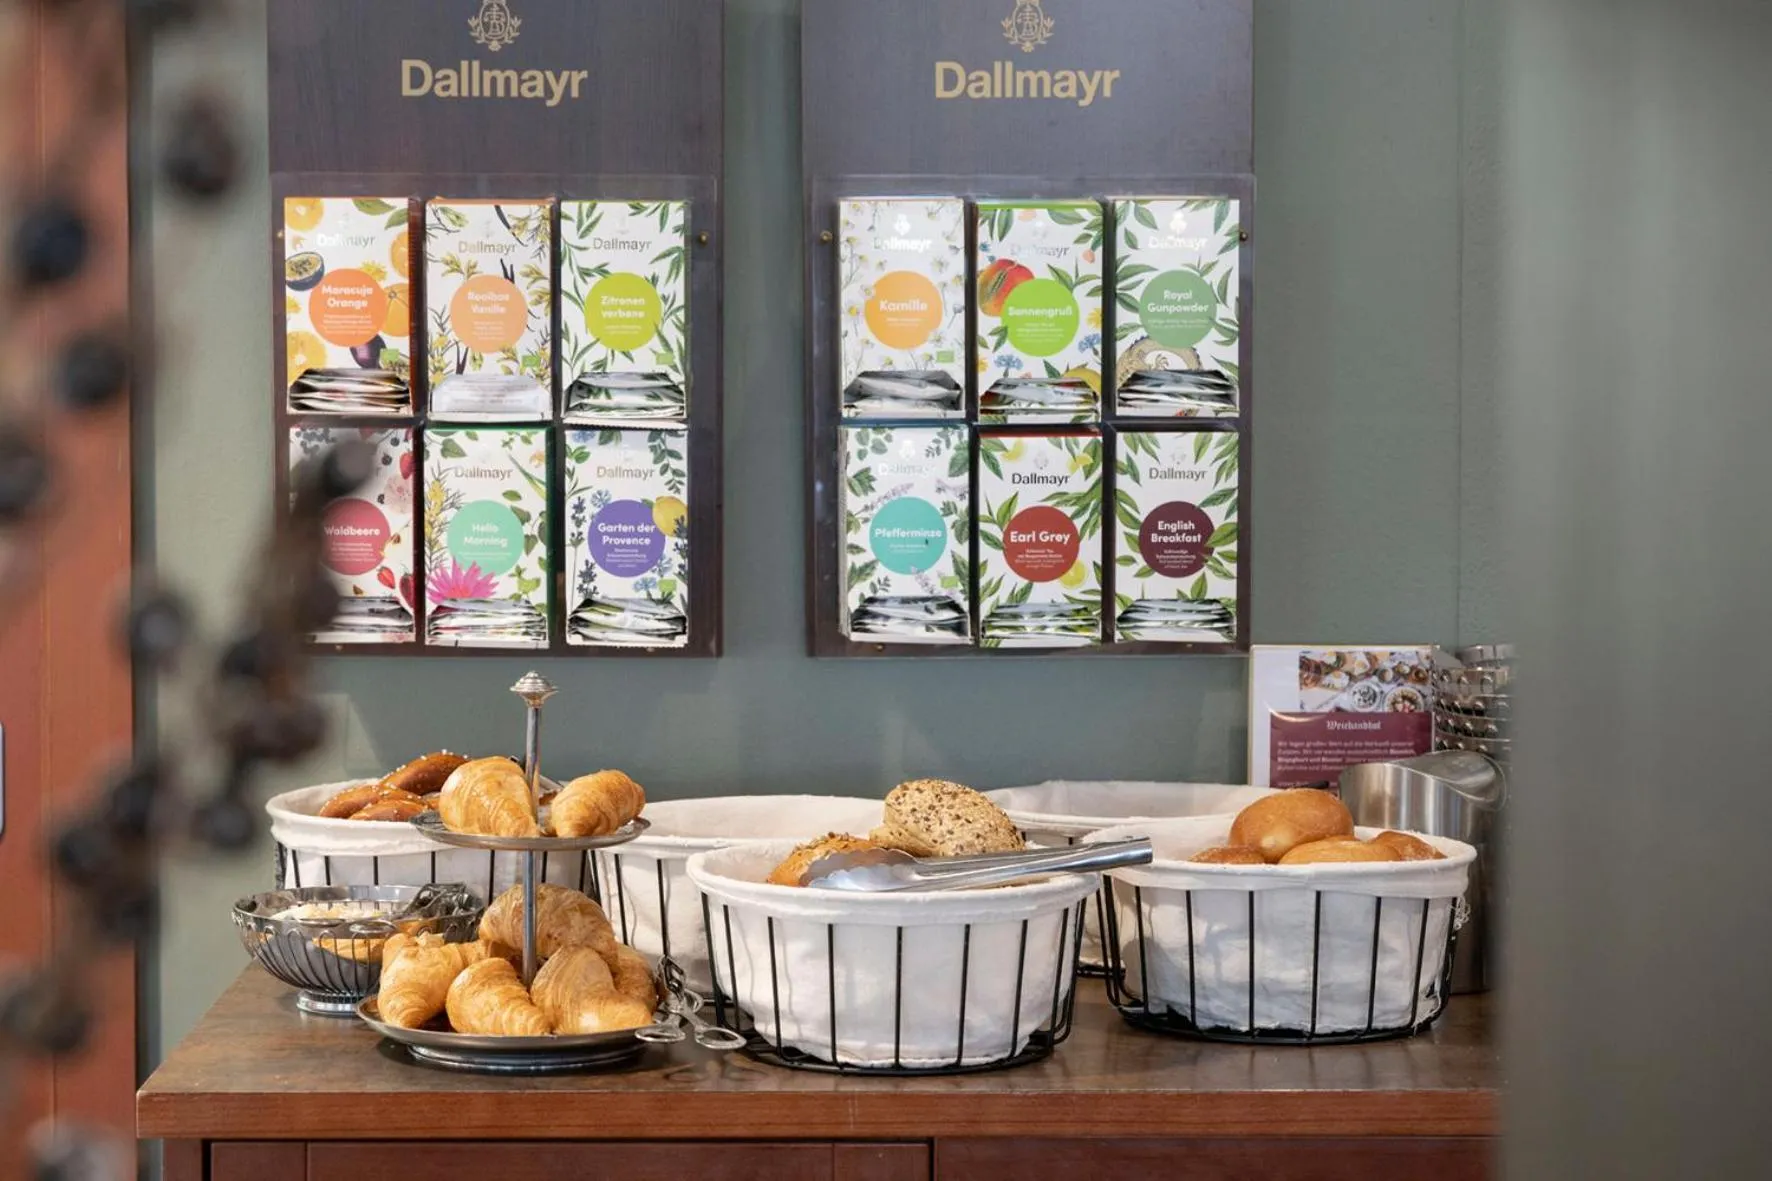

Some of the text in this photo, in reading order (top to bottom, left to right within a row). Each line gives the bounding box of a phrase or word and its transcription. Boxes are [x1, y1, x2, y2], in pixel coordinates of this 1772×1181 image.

[401, 59, 588, 107] Dallmayr
[934, 61, 1120, 107] Dallmayr
[457, 239, 517, 255] Dallmayr
[592, 237, 653, 252] Dallmayr
[321, 284, 373, 297] Maracuja
[1163, 289, 1193, 302] Royal
[326, 297, 369, 309] Orange
[600, 295, 646, 306] Zitronen
[879, 299, 928, 312] Kamille
[1008, 305, 1073, 319] Sonnengruß
[1147, 302, 1209, 315] Gunpowder
[454, 465, 513, 481] Dallmayr
[596, 465, 655, 482] Dallmayr
[1011, 472, 1071, 487] Dallmayr
[1148, 466, 1207, 481] Dallmayr
[323, 525, 381, 536] Waldbeere
[471, 523, 499, 533] Hello
[597, 522, 656, 533] Garten der
[1157, 520, 1195, 533] English
[602, 535, 652, 546] Provence
[874, 528, 942, 540] Pfefferminze
[1009, 530, 1071, 545] Earl Grey
[1150, 533, 1202, 543] Breakfast
[463, 536, 508, 548] Morning
